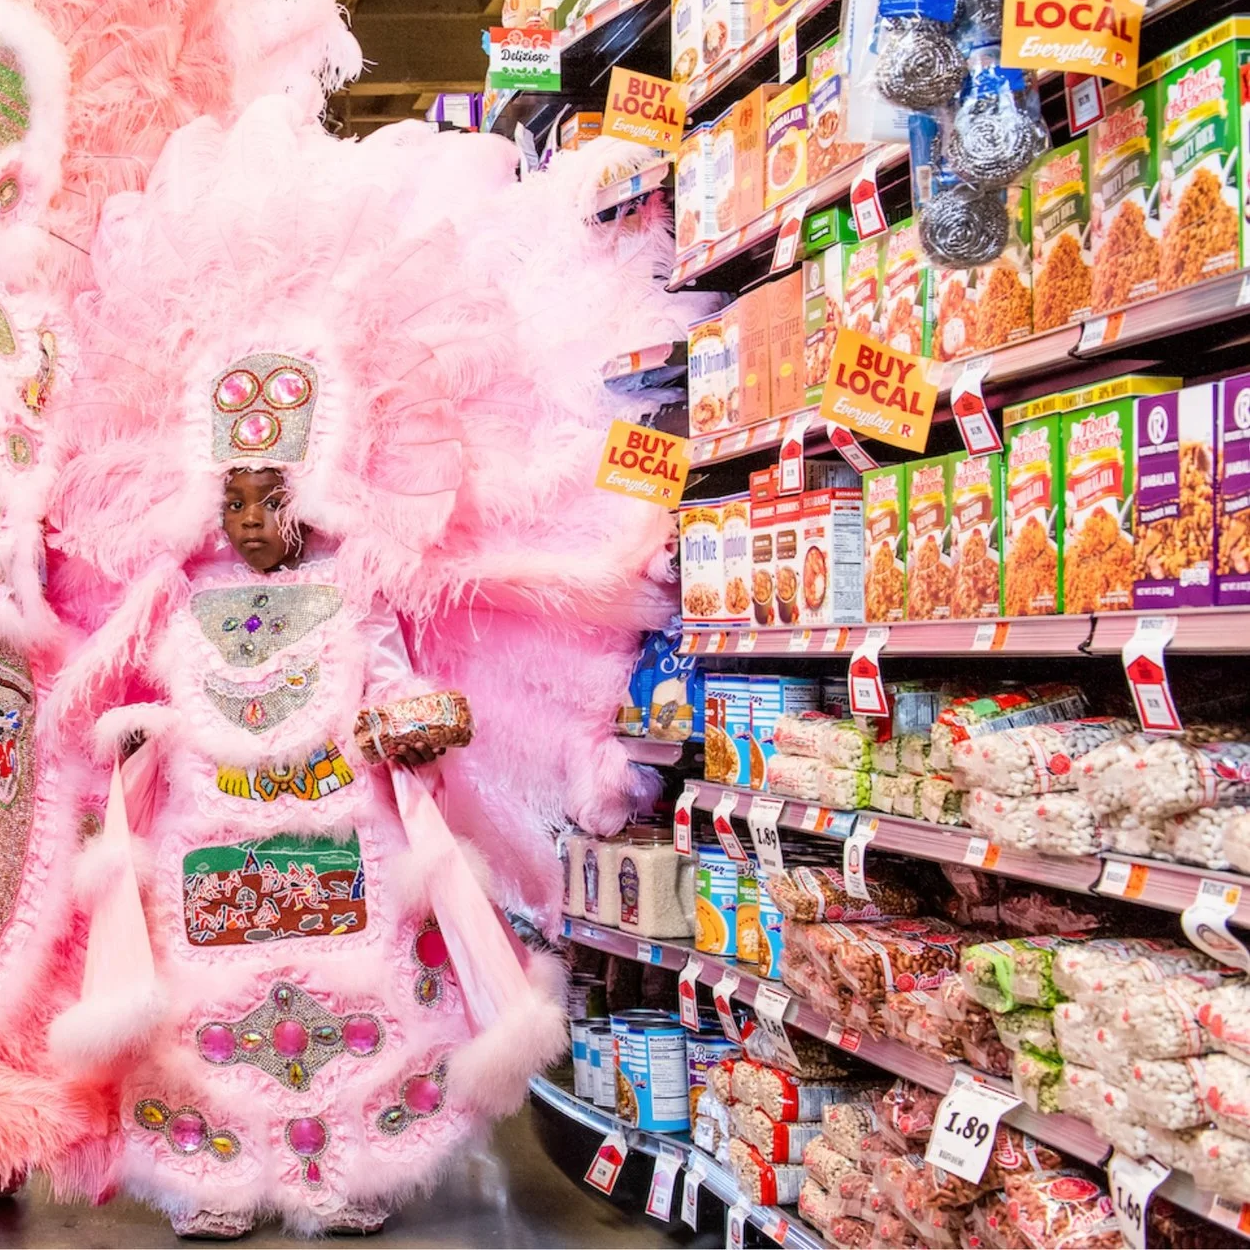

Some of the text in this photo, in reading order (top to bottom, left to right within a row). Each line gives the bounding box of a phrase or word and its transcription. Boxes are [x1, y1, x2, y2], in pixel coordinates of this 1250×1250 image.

[1015, 2, 1132, 42] LOCAL
[500, 48, 551, 64] Delizioso
[1019, 35, 1108, 66] Everyday
[627, 77, 672, 100] BUY
[612, 94, 680, 126] LOCAL
[611, 118, 661, 143] Everyday
[856, 344, 918, 379] BUY
[836, 363, 925, 416] LOCAL
[832, 398, 896, 435] Everyday
[626, 431, 677, 455] BUY
[608, 447, 680, 482] LOCAL
[605, 471, 658, 496] Everyday
[685, 536, 701, 567] Dirty
[702, 534, 717, 562] Rice
[755, 827, 777, 850] 1.89
[944, 1111, 990, 1148] 1.89
[1116, 1186, 1143, 1231] 1.69
